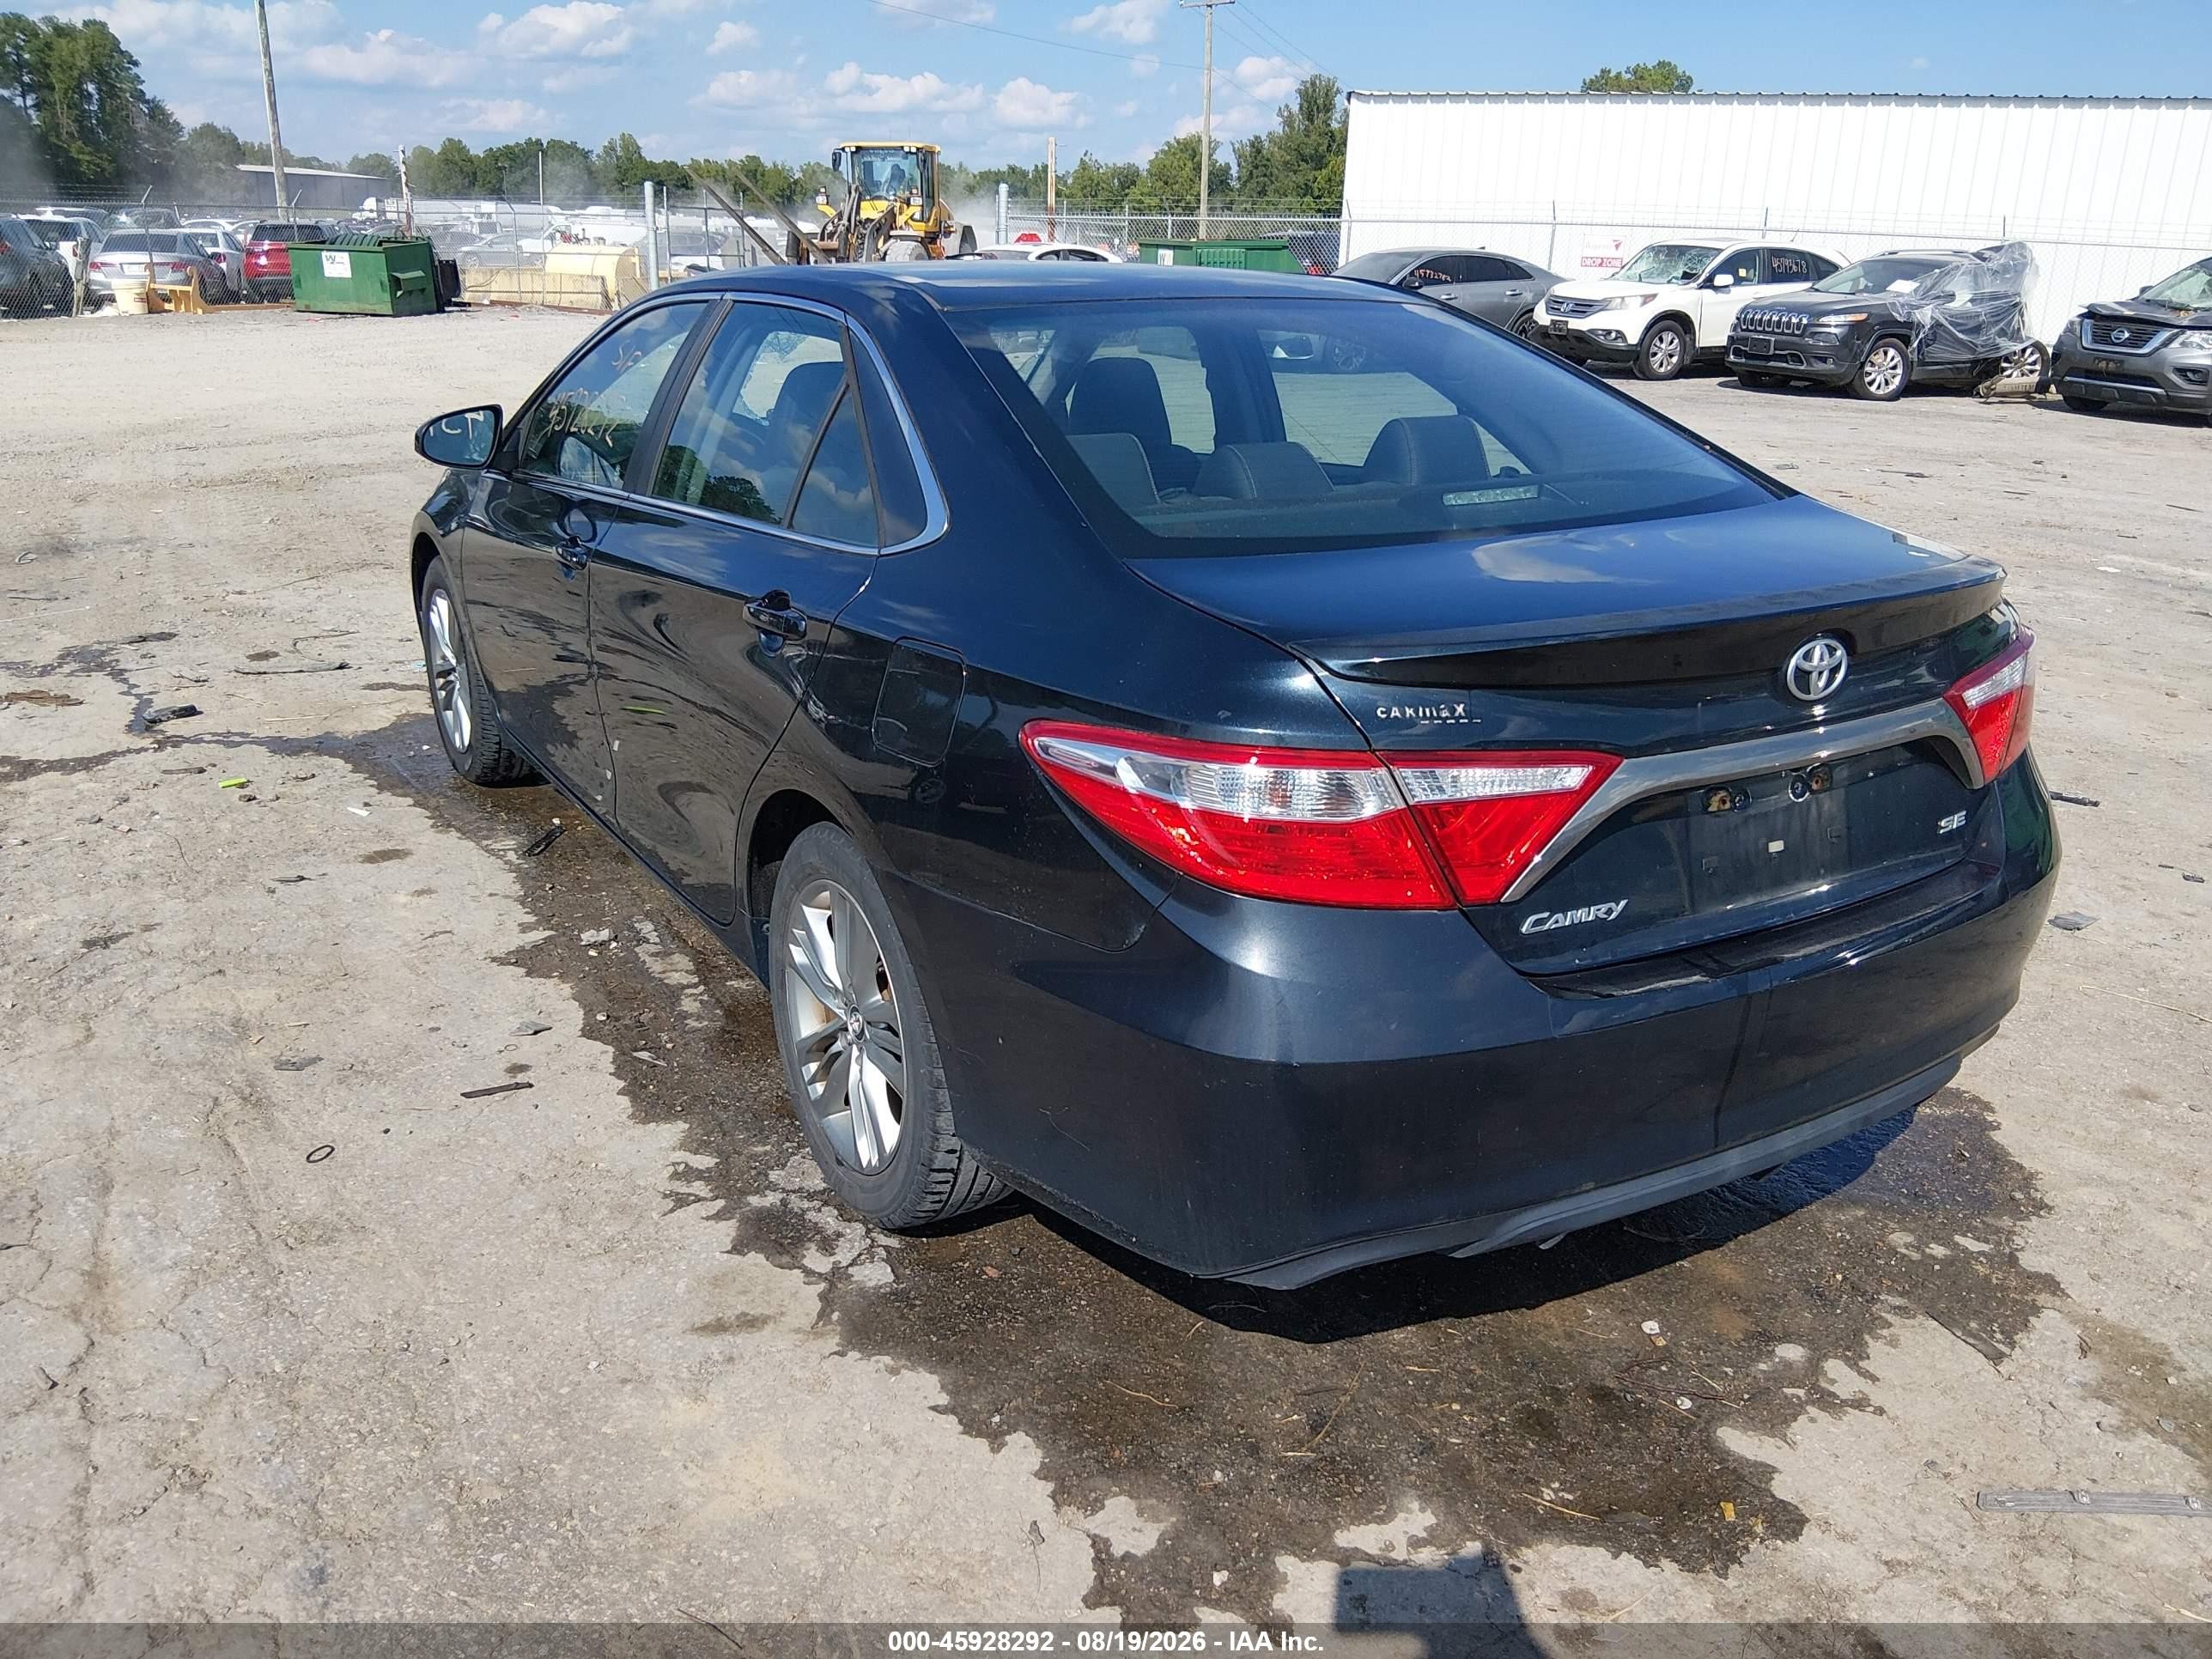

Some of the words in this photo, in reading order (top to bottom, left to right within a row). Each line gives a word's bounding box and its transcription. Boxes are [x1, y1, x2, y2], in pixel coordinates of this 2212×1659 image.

[1582, 258, 1601, 266] DROP
[1602, 258, 1621, 267] ZONE
[1771, 256, 1807, 274] 45793678
[1937, 811, 1967, 834] SE
[1521, 899, 1629, 934] CAMRY
